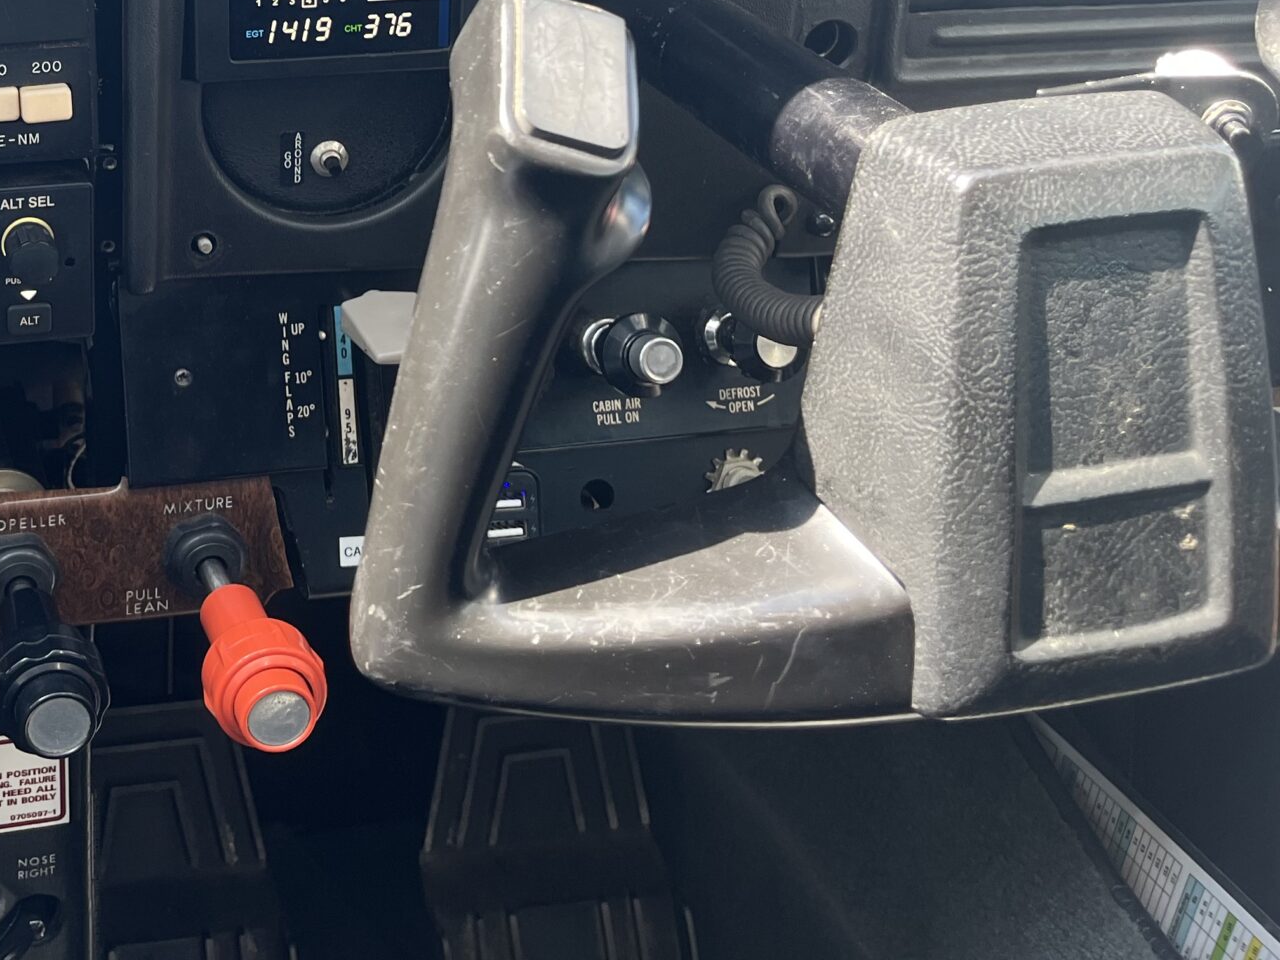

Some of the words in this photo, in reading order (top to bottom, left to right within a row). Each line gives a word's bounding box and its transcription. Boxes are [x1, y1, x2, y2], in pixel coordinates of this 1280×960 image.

[246, 30, 264, 38] EGT
[269, 17, 332, 43] 1419
[364, 12, 412, 38] 376
[32, 61, 62, 74] 200
[294, 132, 302, 183] AROUND
[0, 198, 24, 210] ALT
[28, 196, 54, 208] SEL
[20, 315, 40, 326] ALT
[291, 323, 305, 335] UP
[719, 386, 760, 400] DEFROST
[593, 400, 621, 412] CABIN
[626, 398, 641, 409] AIR
[729, 401, 755, 413] OPEN
[597, 412, 621, 425] PULL
[626, 411, 639, 423] ON
[163, 496, 233, 514] MIXTURE
[126, 588, 161, 602] PULL
[126, 600, 169, 615] LEAN
[7, 766, 56, 779] POSITION
[20, 775, 56, 786] FAILURE
[2, 788, 32, 796] HEED
[36, 784, 56, 792] ALL
[22, 792, 56, 804] BODILY
[10, 809, 56, 821] 0705097-1
[18, 854, 56, 867] NOSE
[18, 866, 56, 879] RIGHT
